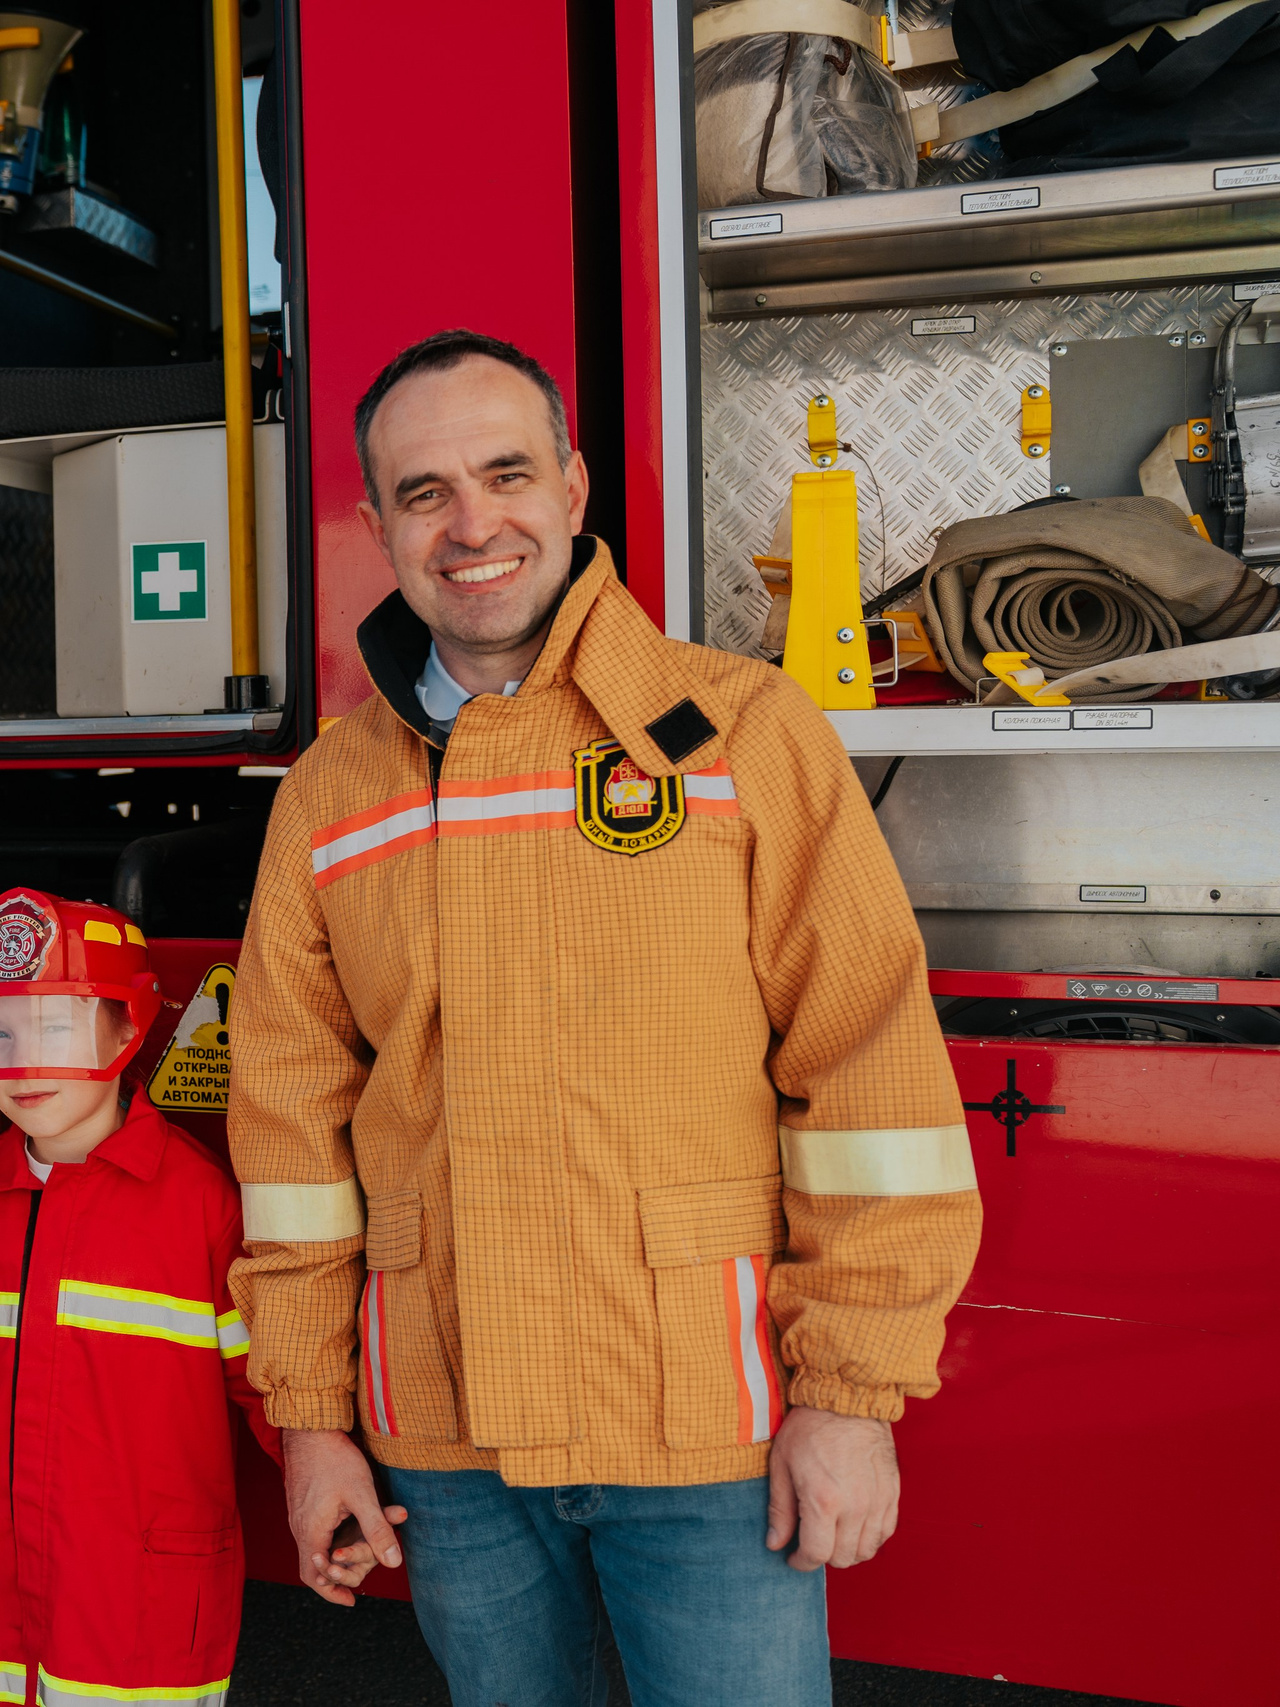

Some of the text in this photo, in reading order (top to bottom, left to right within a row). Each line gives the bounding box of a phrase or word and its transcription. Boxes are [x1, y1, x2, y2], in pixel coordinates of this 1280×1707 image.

[1109, 711, 1139, 719] НАПОРНЫЕ
[618, 804, 644, 815] ДЮП
[585, 812, 679, 848] ЮНЫЙ ПОЖАРНЫЙ
[14, 915, 41, 928] FIGHTER
[23, 941, 30, 952] D
[173, 1062, 231, 1074] ОТКРЫВ
[168, 1075, 176, 1086] И
